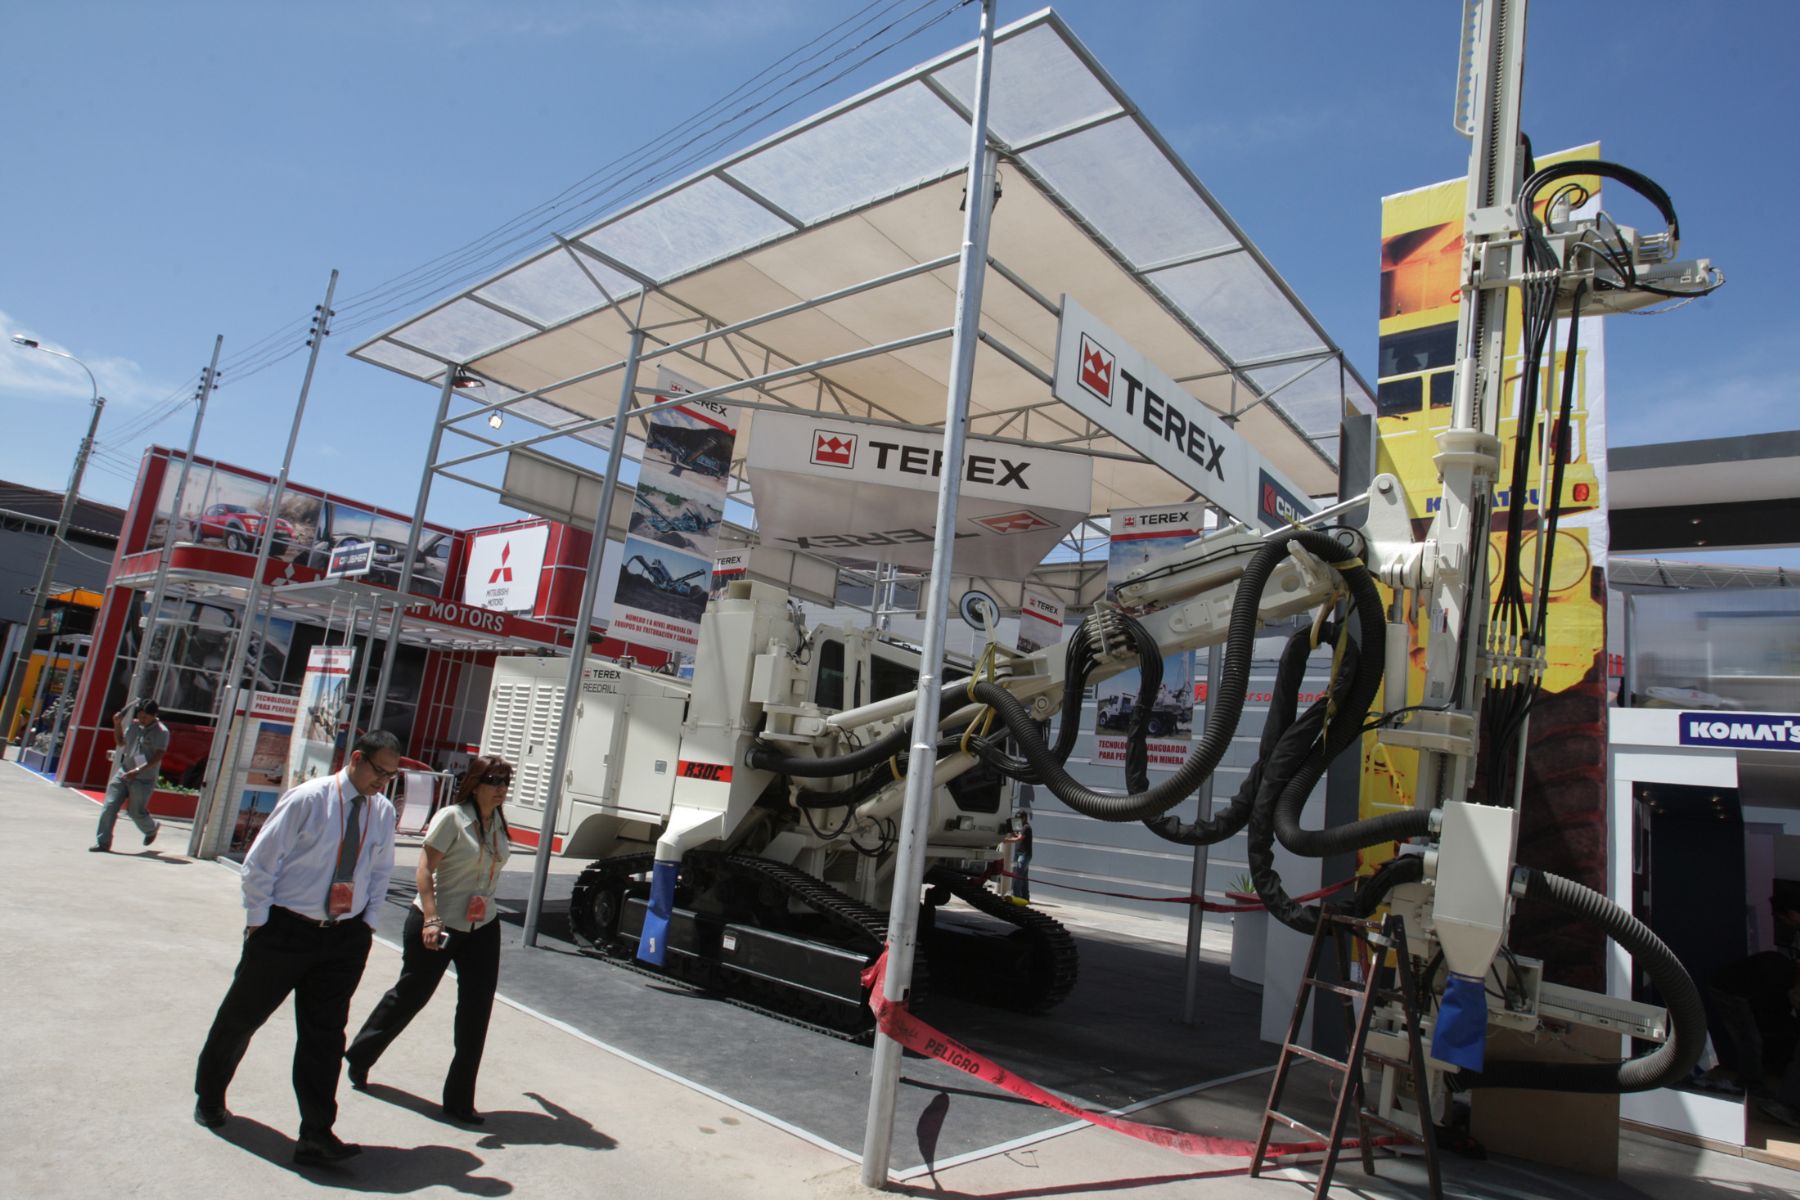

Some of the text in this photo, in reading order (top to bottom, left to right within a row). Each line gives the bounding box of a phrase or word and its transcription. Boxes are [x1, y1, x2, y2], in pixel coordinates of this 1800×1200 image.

[685, 389, 728, 417] REX
[1120, 368, 1226, 482] TEREX
[1139, 511, 1189, 525] TEREX
[1037, 600, 1059, 616] TEREX
[429, 601, 505, 632] MOTORS
[593, 669, 621, 680] TEREX
[583, 682, 618, 694] REEDRILL
[271, 705, 297, 715] PERFORA
[1159, 755, 1184, 765] MINERA
[684, 762, 724, 781] R30C
[924, 1038, 980, 1076] PELIGRO
